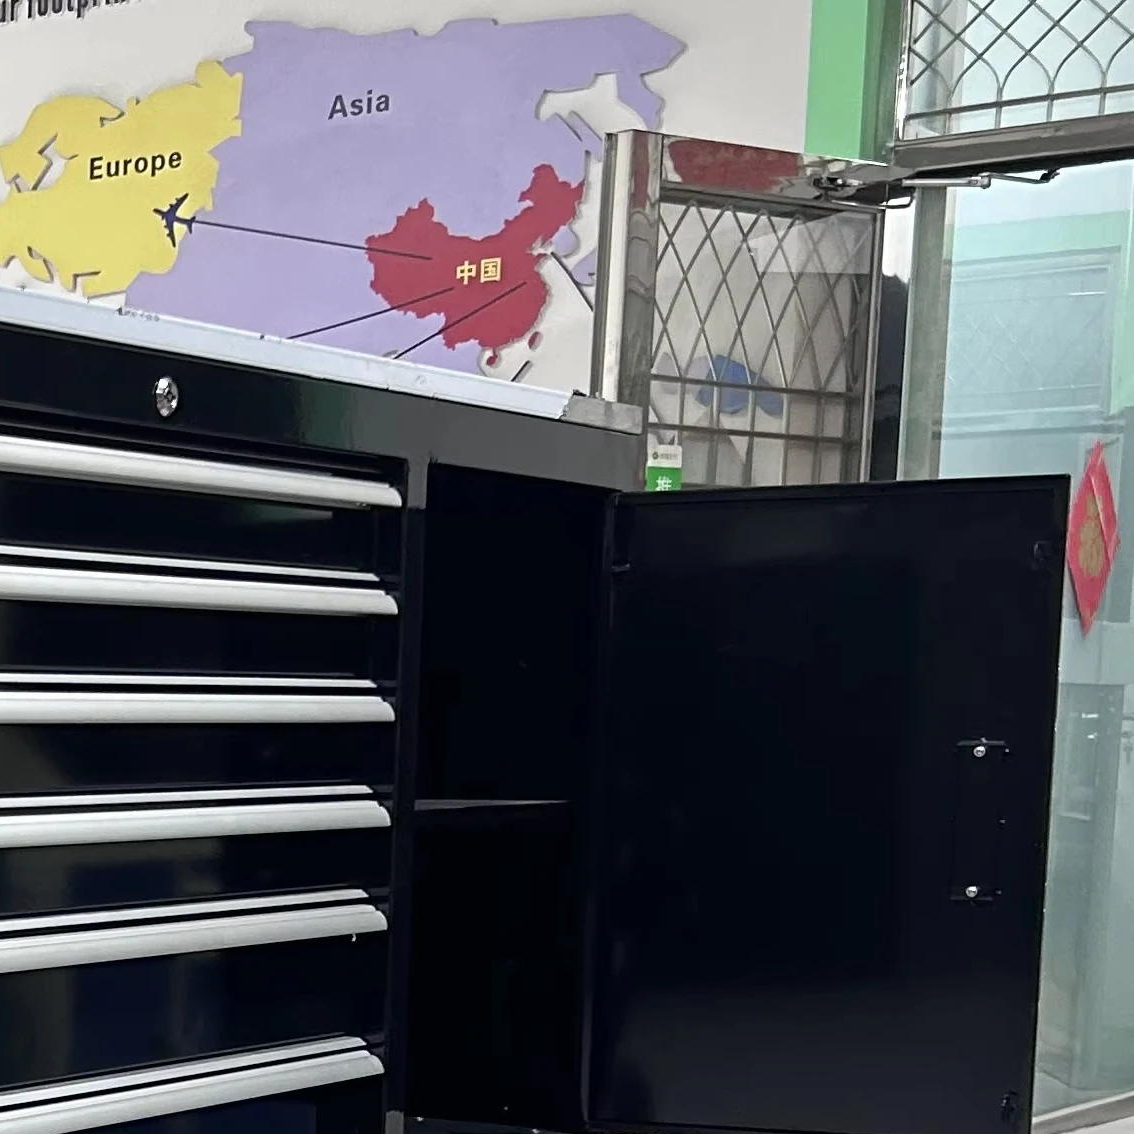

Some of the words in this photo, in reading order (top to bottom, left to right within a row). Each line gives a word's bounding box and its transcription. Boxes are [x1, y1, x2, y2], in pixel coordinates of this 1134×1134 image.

[328, 91, 392, 120] Asia
[89, 147, 183, 181] Europe
[455, 257, 502, 284] 中国
